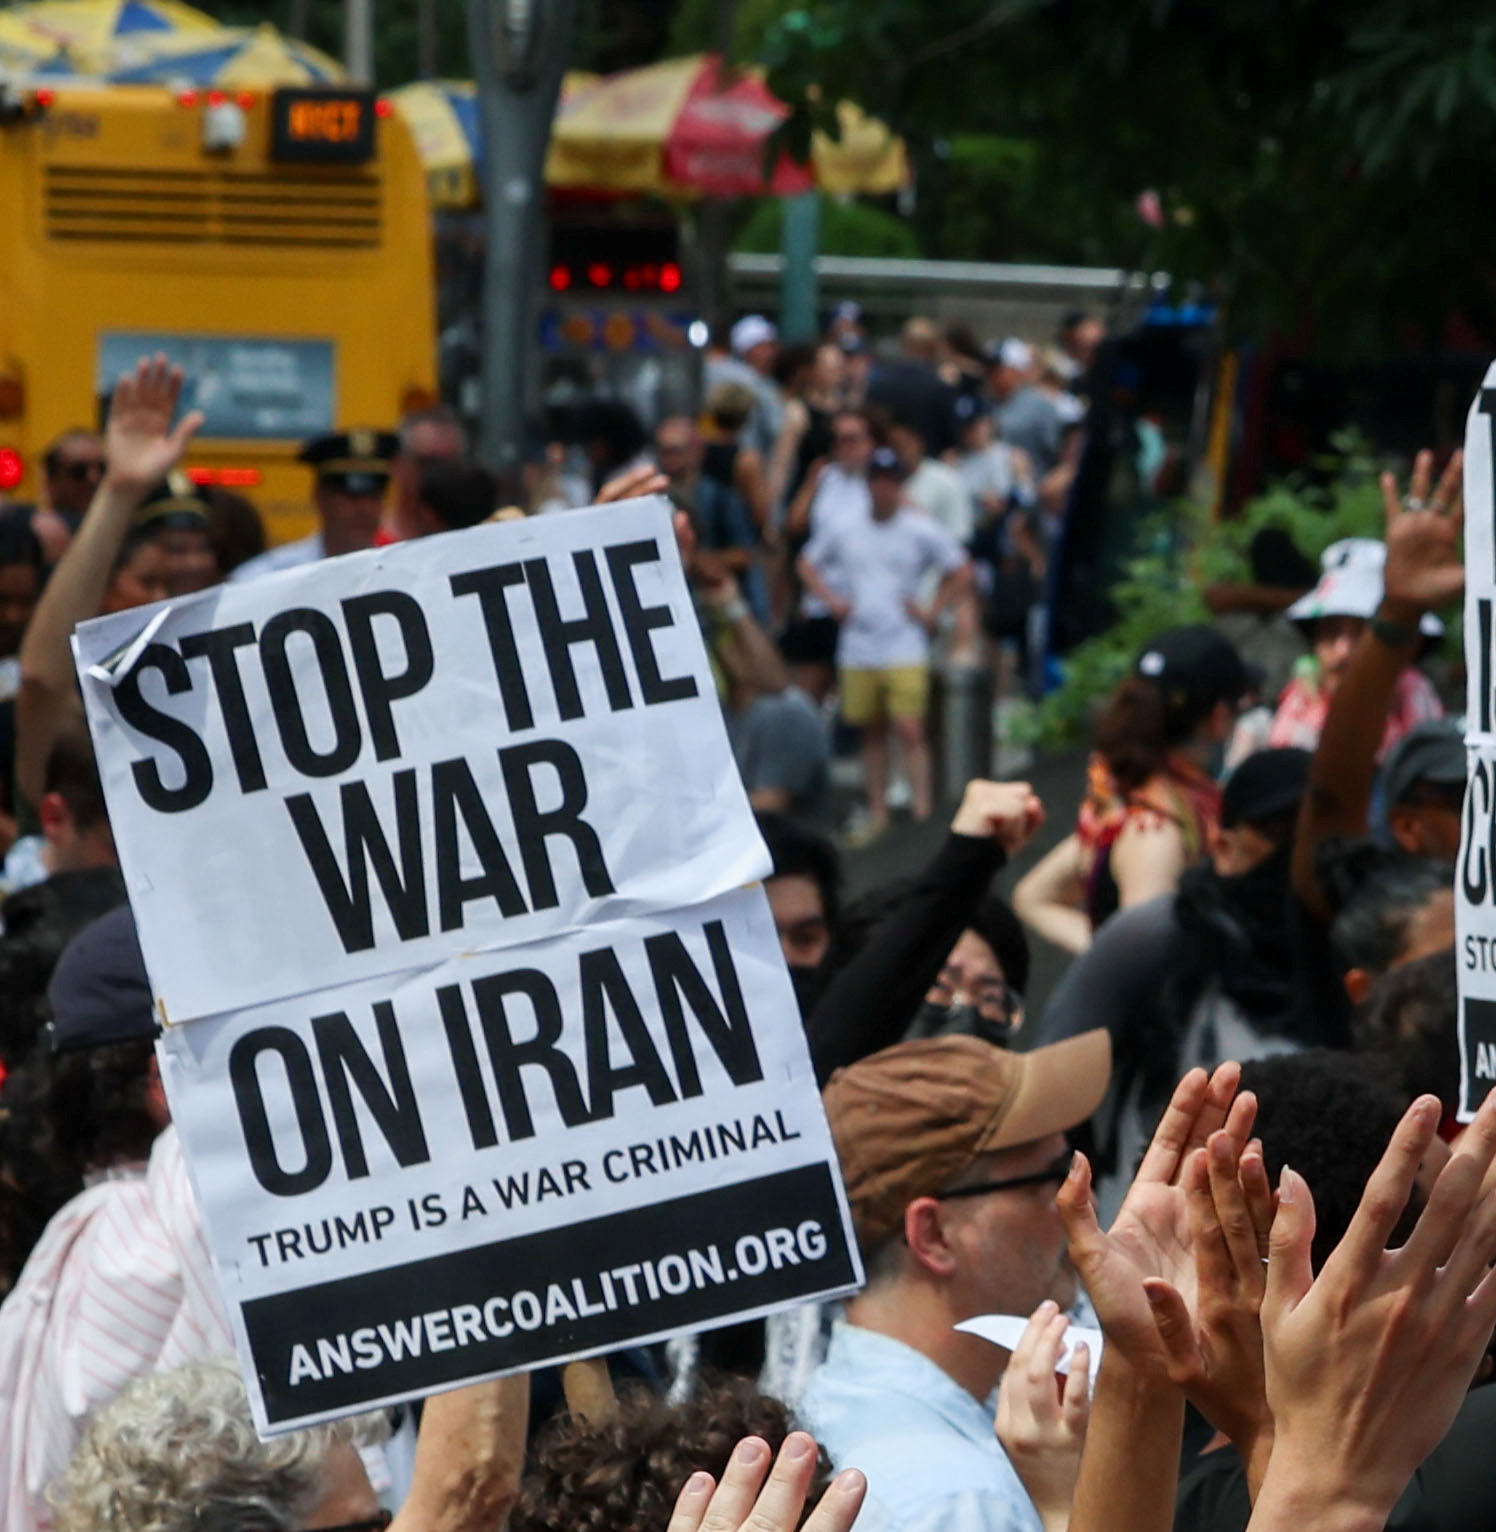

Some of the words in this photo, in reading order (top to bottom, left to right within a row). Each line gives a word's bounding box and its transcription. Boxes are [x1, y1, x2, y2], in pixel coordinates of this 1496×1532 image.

[111, 588, 435, 813] STOP
[450, 538, 700, 732] THE
[284, 738, 616, 953] WAR
[227, 1000, 431, 1198] ON
[435, 920, 765, 1151] IRAN
[247, 1205, 397, 1267] TRUMP
[408, 1193, 447, 1232] IS
[460, 1187, 487, 1221] A
[492, 1159, 591, 1210] WAR
[602, 1109, 801, 1184] CRIMINAL
[288, 1219, 828, 1387] ANSWERCOALITION.ORG
